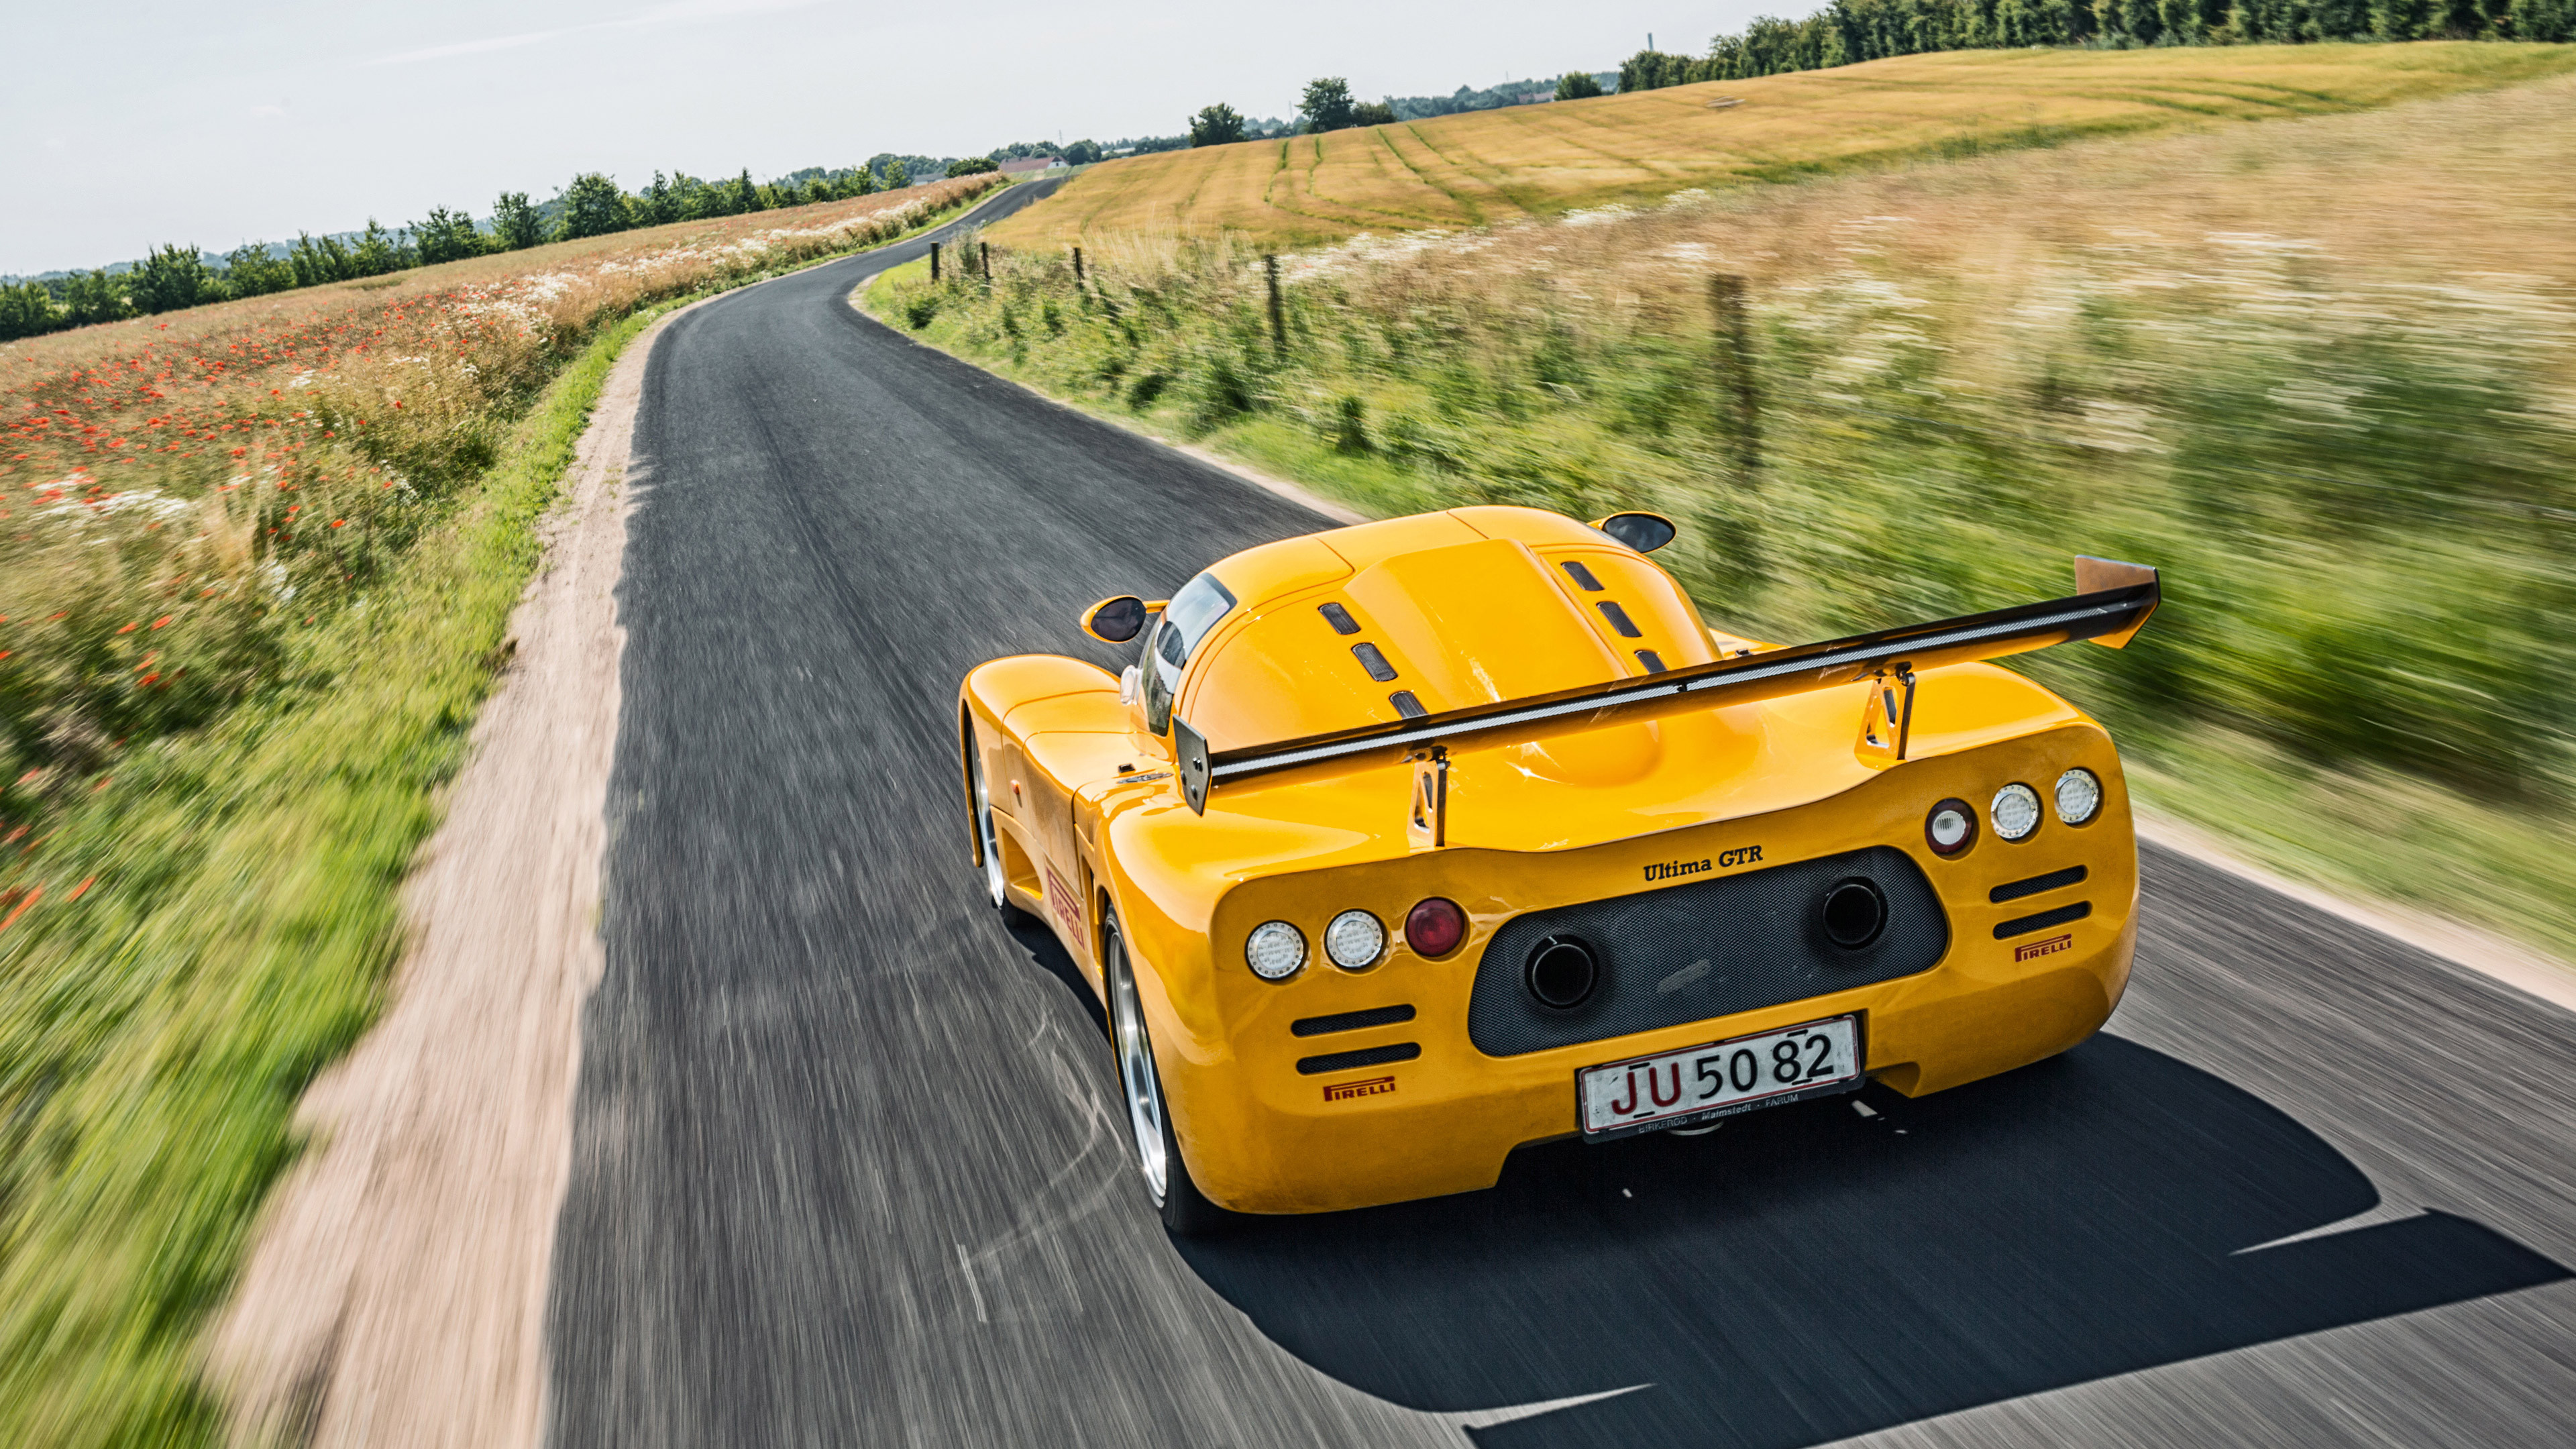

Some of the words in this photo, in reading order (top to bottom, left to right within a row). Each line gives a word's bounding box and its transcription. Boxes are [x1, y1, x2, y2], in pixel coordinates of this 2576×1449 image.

[1644, 859, 1712, 881] Ultima
[1719, 845, 1763, 867] GTR
[1046, 866, 1085, 951] PIRELLI
[2015, 933, 2072, 963] PIRELLI
[1323, 1075, 1396, 1102] PIRELLI
[1612, 1062, 1682, 1115] JU
[1697, 1049, 1758, 1099] 50
[1772, 1034, 1835, 1083] 82
[1765, 1093, 1799, 1107] FARUM
